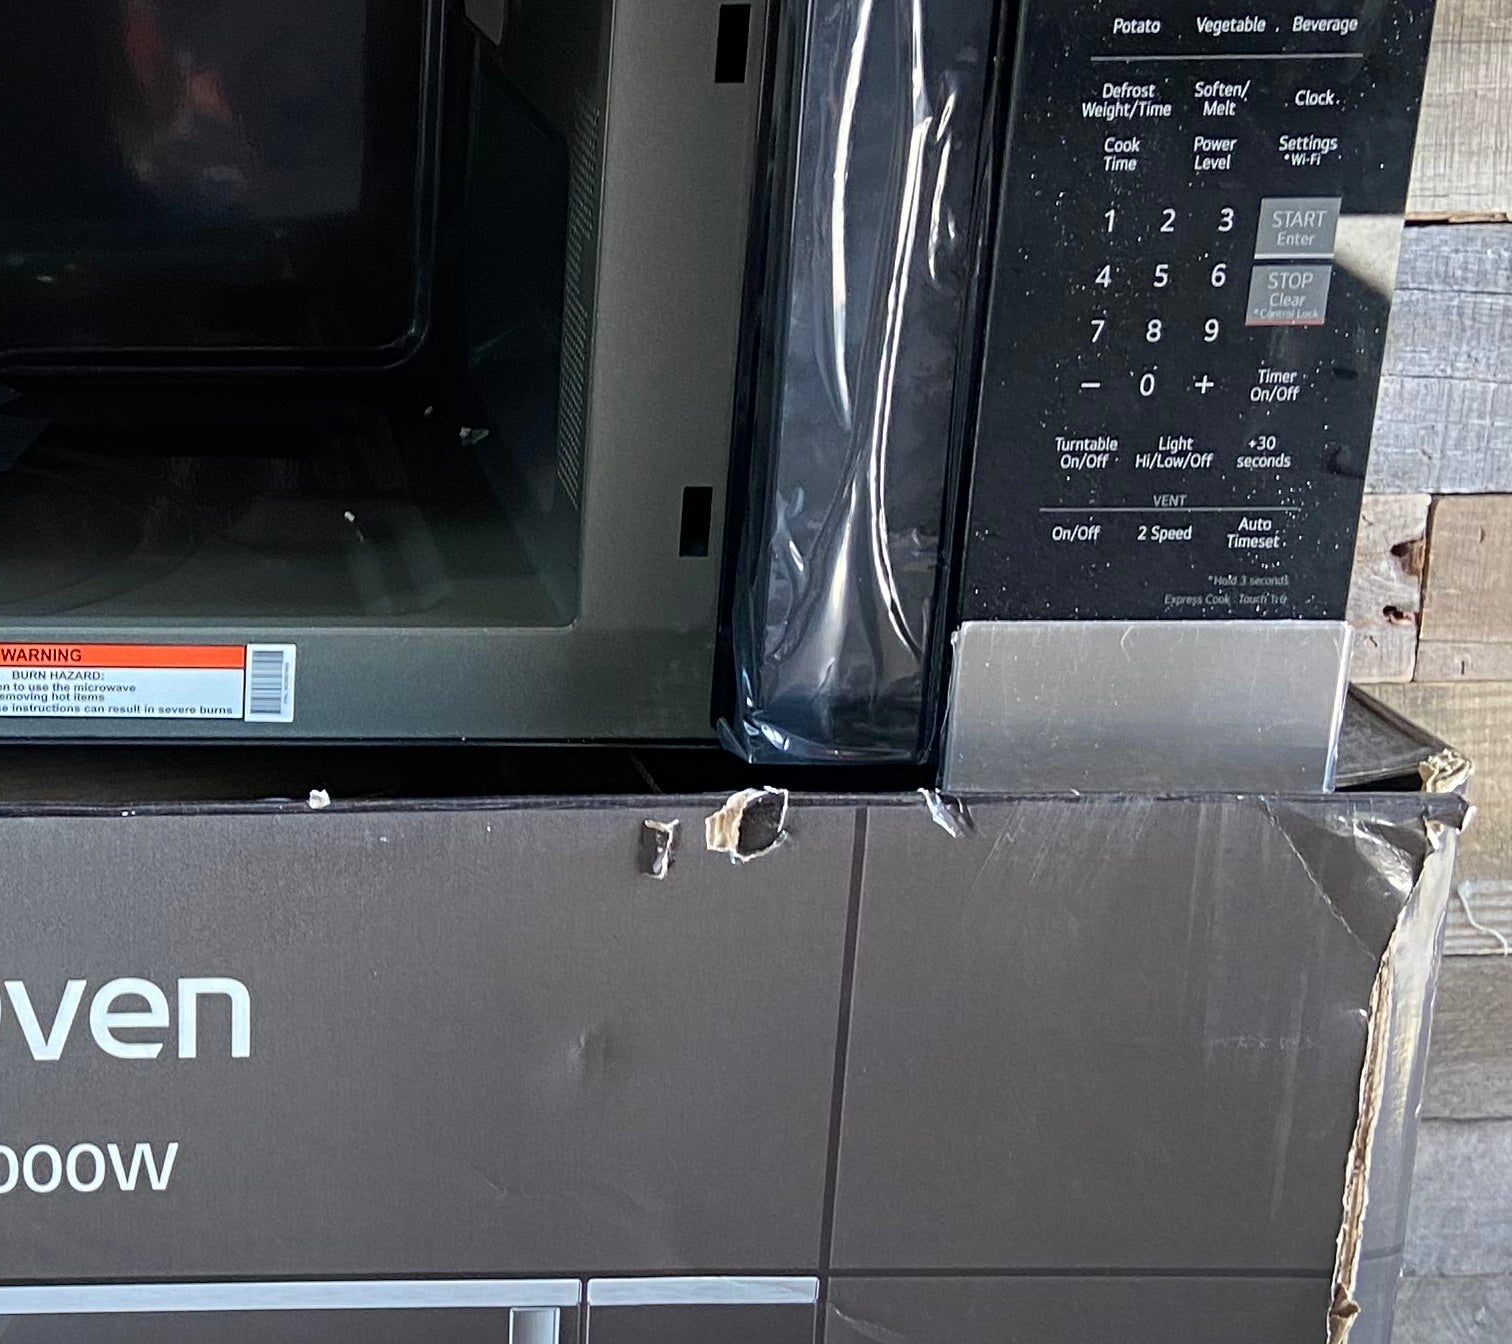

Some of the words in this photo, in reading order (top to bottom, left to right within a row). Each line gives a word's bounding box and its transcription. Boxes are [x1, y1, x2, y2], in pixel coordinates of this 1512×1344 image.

[1113, 17, 1161, 34] Potato
[1196, 15, 1266, 36] Vegetable
[1292, 15, 1358, 35] Beverage
[1102, 82, 1155, 99] Defrost
[1194, 80, 1251, 99] Soften/
[1295, 89, 1335, 106] Clock
[1081, 101, 1172, 121] Weight/Time
[1203, 101, 1236, 116] Melt
[1104, 136, 1140, 153] Cook
[1193, 135, 1237, 152] Power
[1278, 135, 1338, 154] Settings
[1103, 155, 1137, 172] Time
[1194, 154, 1231, 170] Level
[1104, 208, 1115, 233] 1
[1160, 207, 1177, 233] 2
[1218, 207, 1234, 232] 3
[1272, 210, 1328, 229] START
[1276, 231, 1316, 247] Enter
[1095, 264, 1112, 288] 4
[1153, 264, 1169, 288] 5
[1210, 263, 1226, 287] 6
[1267, 271, 1313, 290] STOP
[1269, 292, 1307, 307] Clear
[1090, 318, 1105, 344] 7
[1145, 318, 1162, 343] 8
[1204, 318, 1220, 343] 9
[1258, 368, 1297, 384] Timer
[1139, 373, 1156, 397] 0
[1250, 384, 1300, 402] On/Off
[1055, 436, 1118, 452] Turntable
[1158, 436, 1194, 453] Light
[1248, 436, 1276, 451] +30
[1060, 454, 1108, 469] On/Off
[1135, 453, 1213, 469] Hi/Low/Off
[1237, 453, 1291, 468] seconds
[1153, 494, 1186, 507] VENT
[1238, 517, 1272, 532] Auto
[1052, 525, 1101, 542] On/Off
[1137, 526, 1147, 541] 2
[1150, 525, 1192, 543] Speed
[1227, 533, 1280, 549] Timeset
[1164, 593, 1202, 606] Express
[1205, 593, 1230, 605] Cook
[0, 648, 82, 662] WARNING
[12, 670, 46, 680] BURN
[50, 671, 104, 681] HAZARD:
[14, 682, 25, 691] to
[29, 684, 49, 692] use
[52, 683, 70, 692] the
[73, 683, 136, 692] microwave
[52, 692, 70, 701] hot
[73, 692, 104, 701] items
[12, 703, 80, 713] instructions
[84, 706, 105, 714] can
[108, 705, 140, 714] result
[144, 705, 154, 714] in
[157, 706, 196, 715] severe
[200, 706, 233, 715] burns
